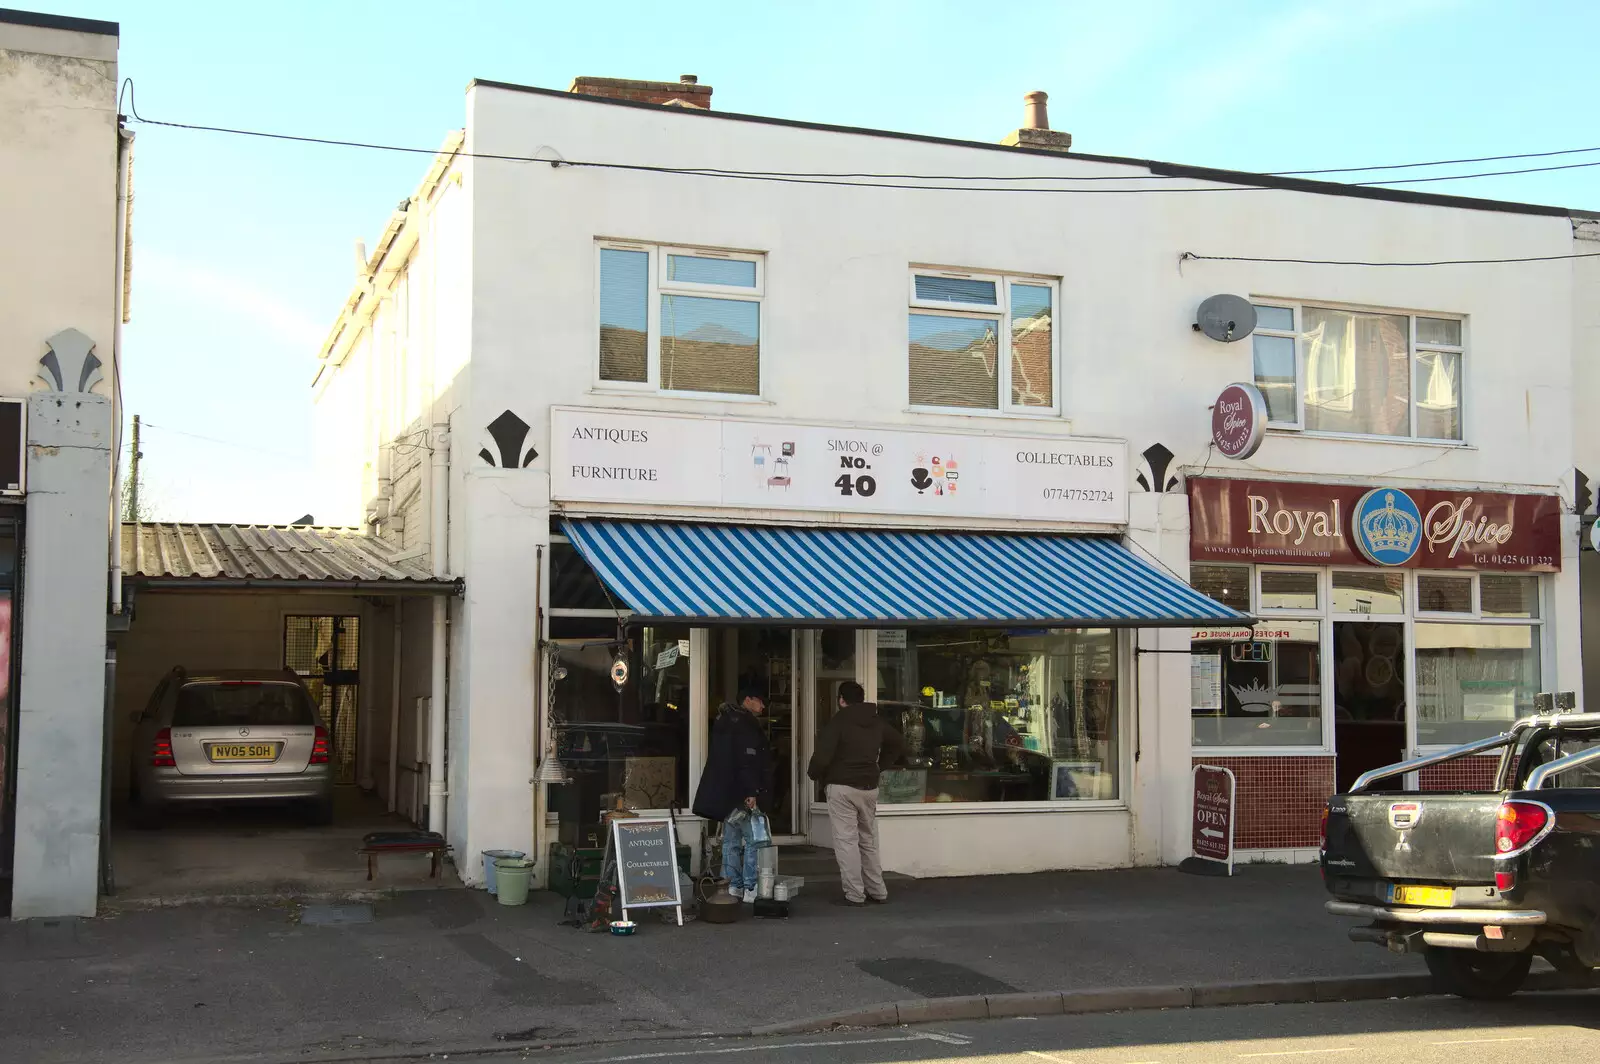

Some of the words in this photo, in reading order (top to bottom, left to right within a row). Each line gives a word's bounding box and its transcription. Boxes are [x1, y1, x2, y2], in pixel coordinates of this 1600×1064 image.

[1220, 397, 1242, 415] Royal
[1224, 412, 1246, 435] Spice
[572, 427, 648, 443] ANTIQUES
[1215, 431, 1230, 450] 01425
[827, 439, 868, 453] SIMON
[872, 443, 884, 456] @
[1016, 451, 1113, 467] COLLECTABLES
[572, 466, 657, 481] FURNITURE
[834, 474, 877, 497] 40
[1043, 488, 1114, 502] 07747752724
[1247, 495, 1343, 545] Royal
[1424, 497, 1513, 559] Spice
[1473, 554, 1489, 564] Tel.
[1491, 554, 1517, 565] 01425
[1519, 555, 1535, 565] 611
[1537, 556, 1553, 566] 322
[1232, 643, 1271, 660] OPEN
[216, 746, 245, 757] NV05
[249, 746, 270, 757] SOH
[1197, 809, 1227, 826] OPEN
[628, 838, 663, 847] ANTIQUES
